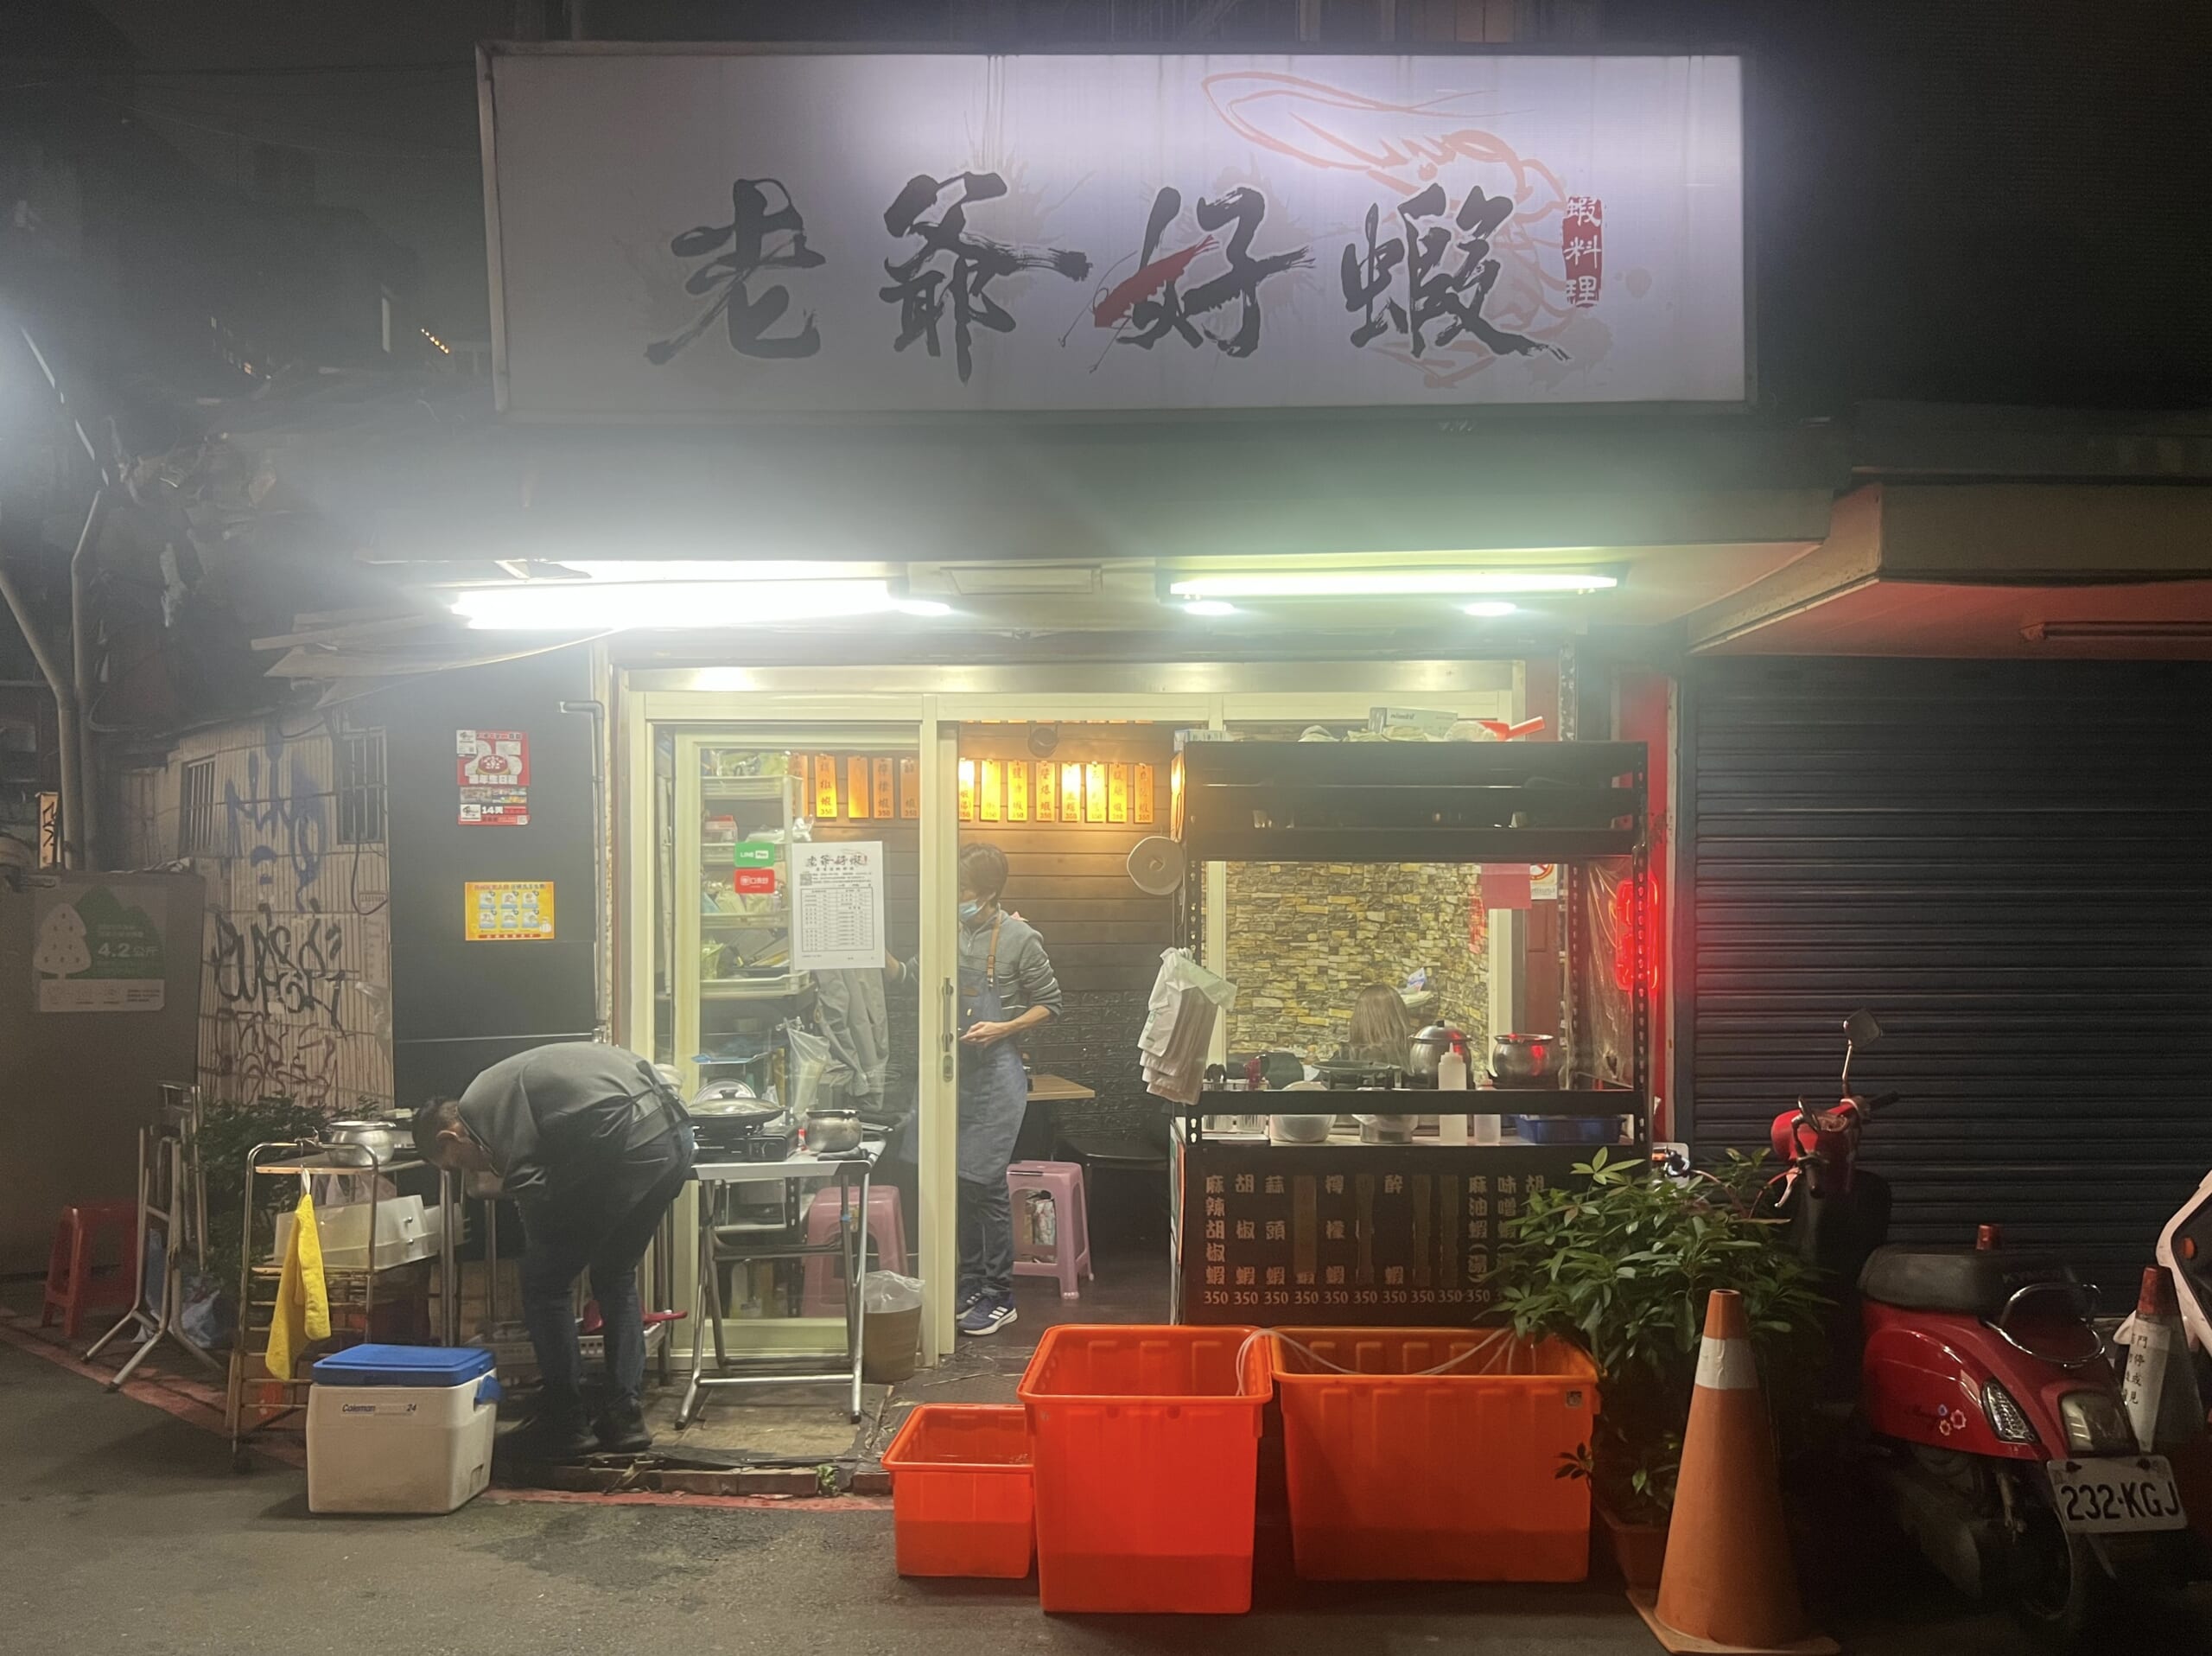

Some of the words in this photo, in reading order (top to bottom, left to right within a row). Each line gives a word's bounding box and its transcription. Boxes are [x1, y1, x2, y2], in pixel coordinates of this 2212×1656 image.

[645, 172, 1568, 383] 老爺好蝦
[1563, 197, 1603, 308] 蝦料理
[1205, 1175, 1225, 1285] 麻辣胡椒蝦
[1235, 1174, 1255, 1285] 胡椒蝦
[1265, 1175, 1287, 1285] 蒜頭蝦
[1204, 1290, 1229, 1305] 350
[1234, 1290, 1258, 1305] 350
[1264, 1290, 1288, 1305] 350
[1294, 1290, 1319, 1305] 350
[1324, 1290, 1349, 1305] 350
[1353, 1290, 1378, 1305] 350
[1382, 1290, 1407, 1303] 350
[1410, 1290, 1435, 1303] 350
[1438, 1290, 1463, 1303] 350
[1465, 1290, 1491, 1303] 350
[342, 1404, 376, 1412] Coleman
[2061, 1481, 2179, 1520] 232-KGJ
